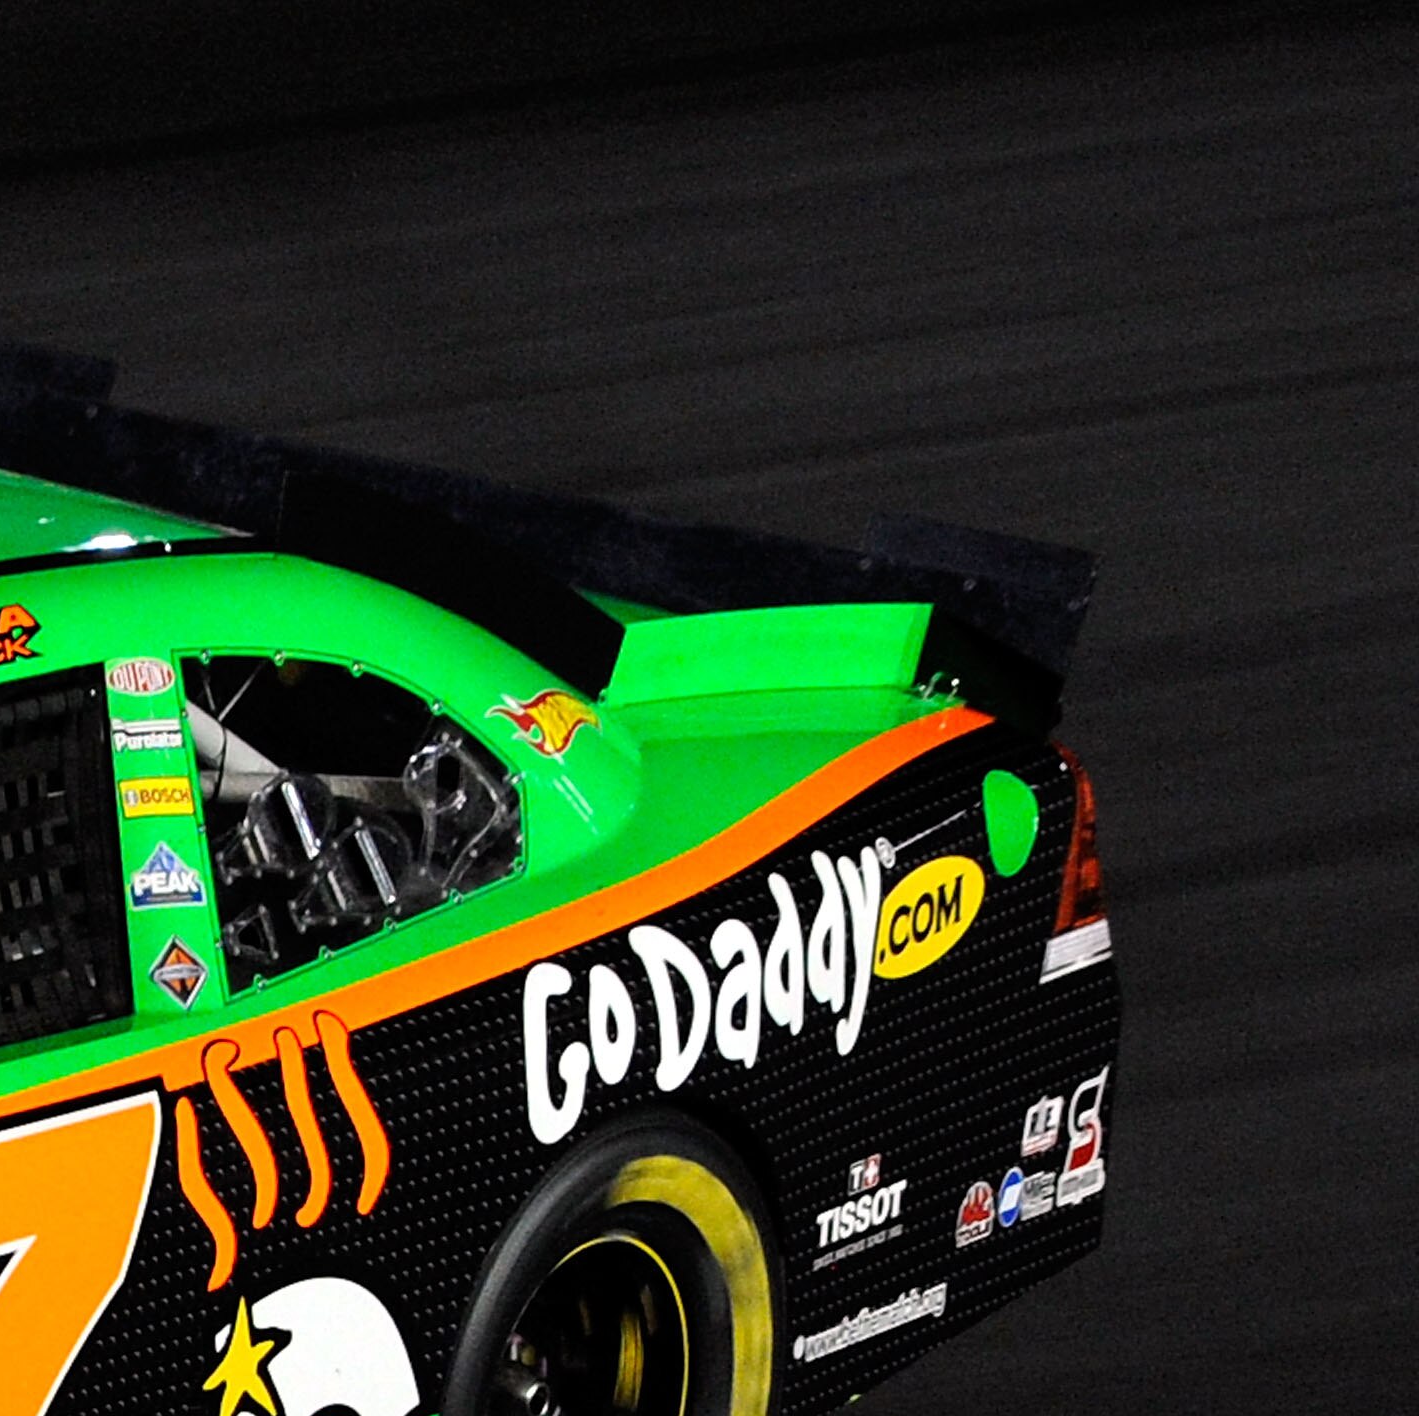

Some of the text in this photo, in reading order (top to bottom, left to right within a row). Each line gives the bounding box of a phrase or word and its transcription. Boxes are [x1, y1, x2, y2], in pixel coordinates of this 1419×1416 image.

[139, 787, 191, 806] BOSCH
[134, 871, 200, 897] PEAK
[816, 1179, 908, 1248] TISSOT
